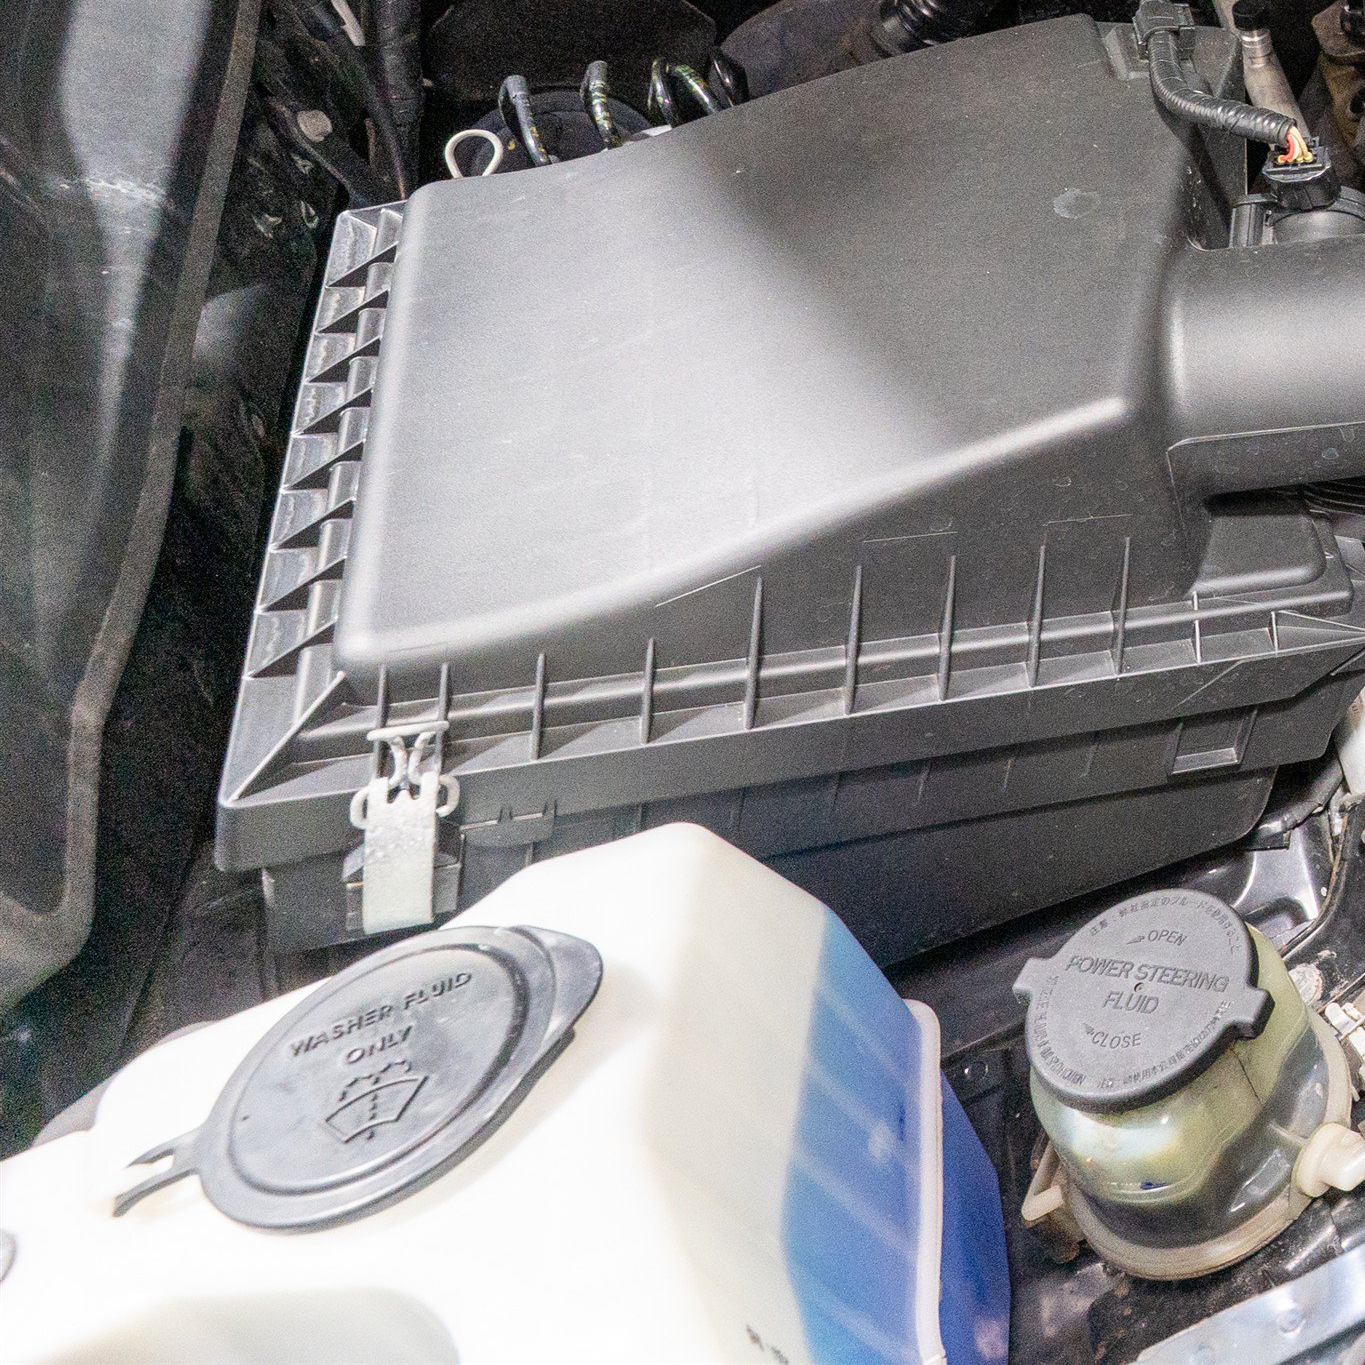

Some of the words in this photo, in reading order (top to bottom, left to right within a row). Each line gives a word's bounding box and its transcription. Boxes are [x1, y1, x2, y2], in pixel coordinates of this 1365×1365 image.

[1147, 929, 1188, 947] OPEN
[1065, 955, 1134, 979] POWER
[1137, 963, 1230, 993] STEERING
[290, 1004, 394, 1057] WASHER
[404, 972, 473, 1011] FLUID
[1103, 991, 1160, 1015] FLUID
[346, 1025, 413, 1065] ONLY
[1091, 1031, 1142, 1050] CLOSE
